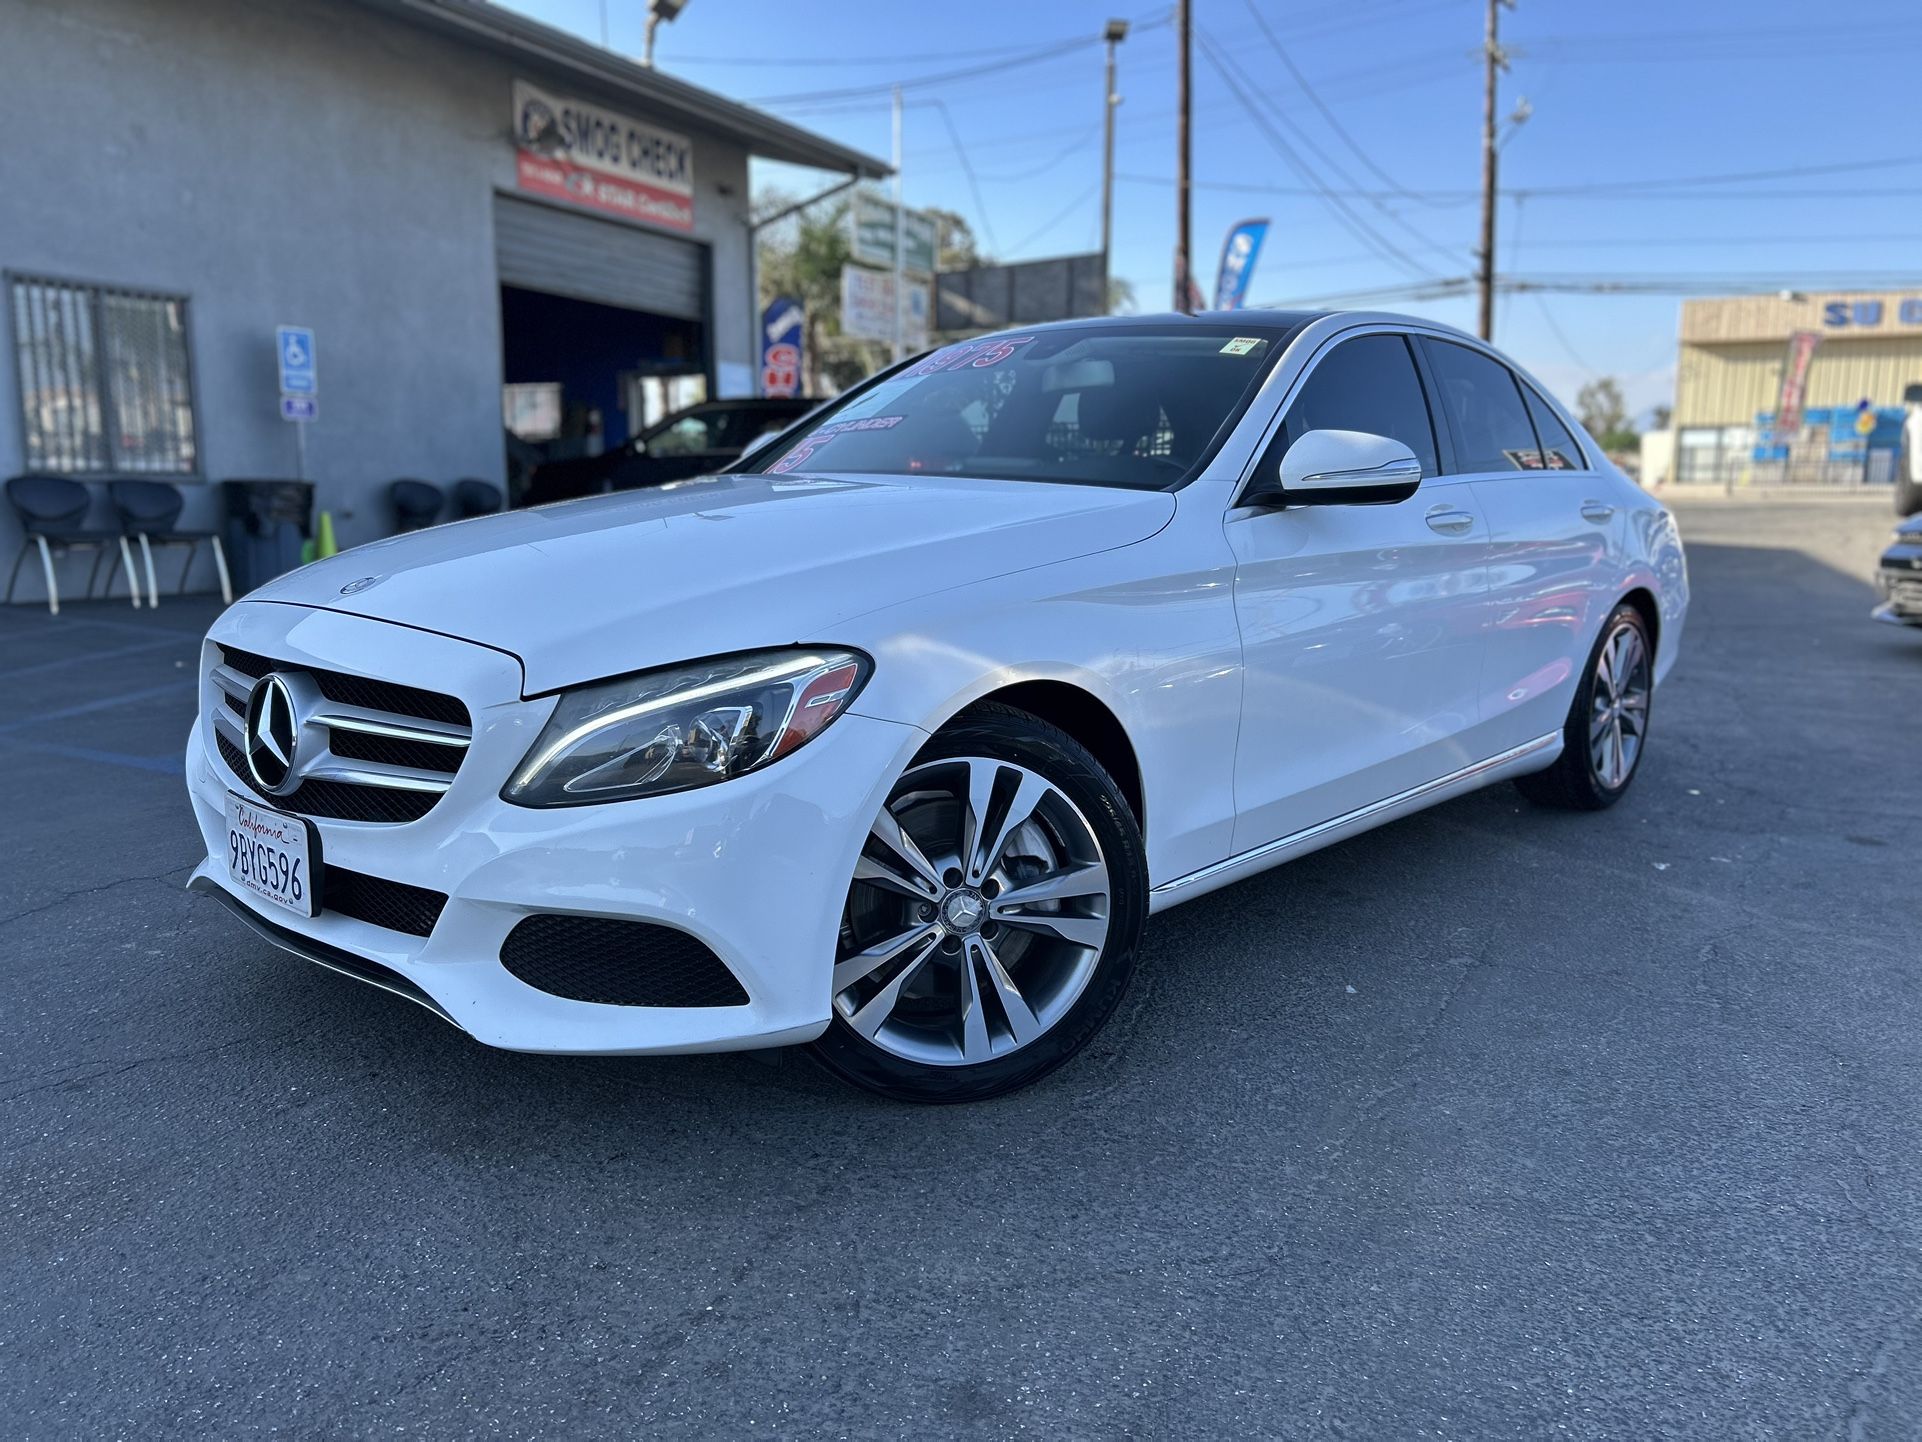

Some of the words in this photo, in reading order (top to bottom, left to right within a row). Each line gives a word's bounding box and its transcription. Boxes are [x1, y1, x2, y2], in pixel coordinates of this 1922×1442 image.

[561, 107, 621, 163] SMOG
[625, 130, 686, 184] CHECK
[238, 803, 290, 845] California
[230, 829, 302, 901] 9BYG596
[246, 879, 288, 905] dmv.ca.gov
